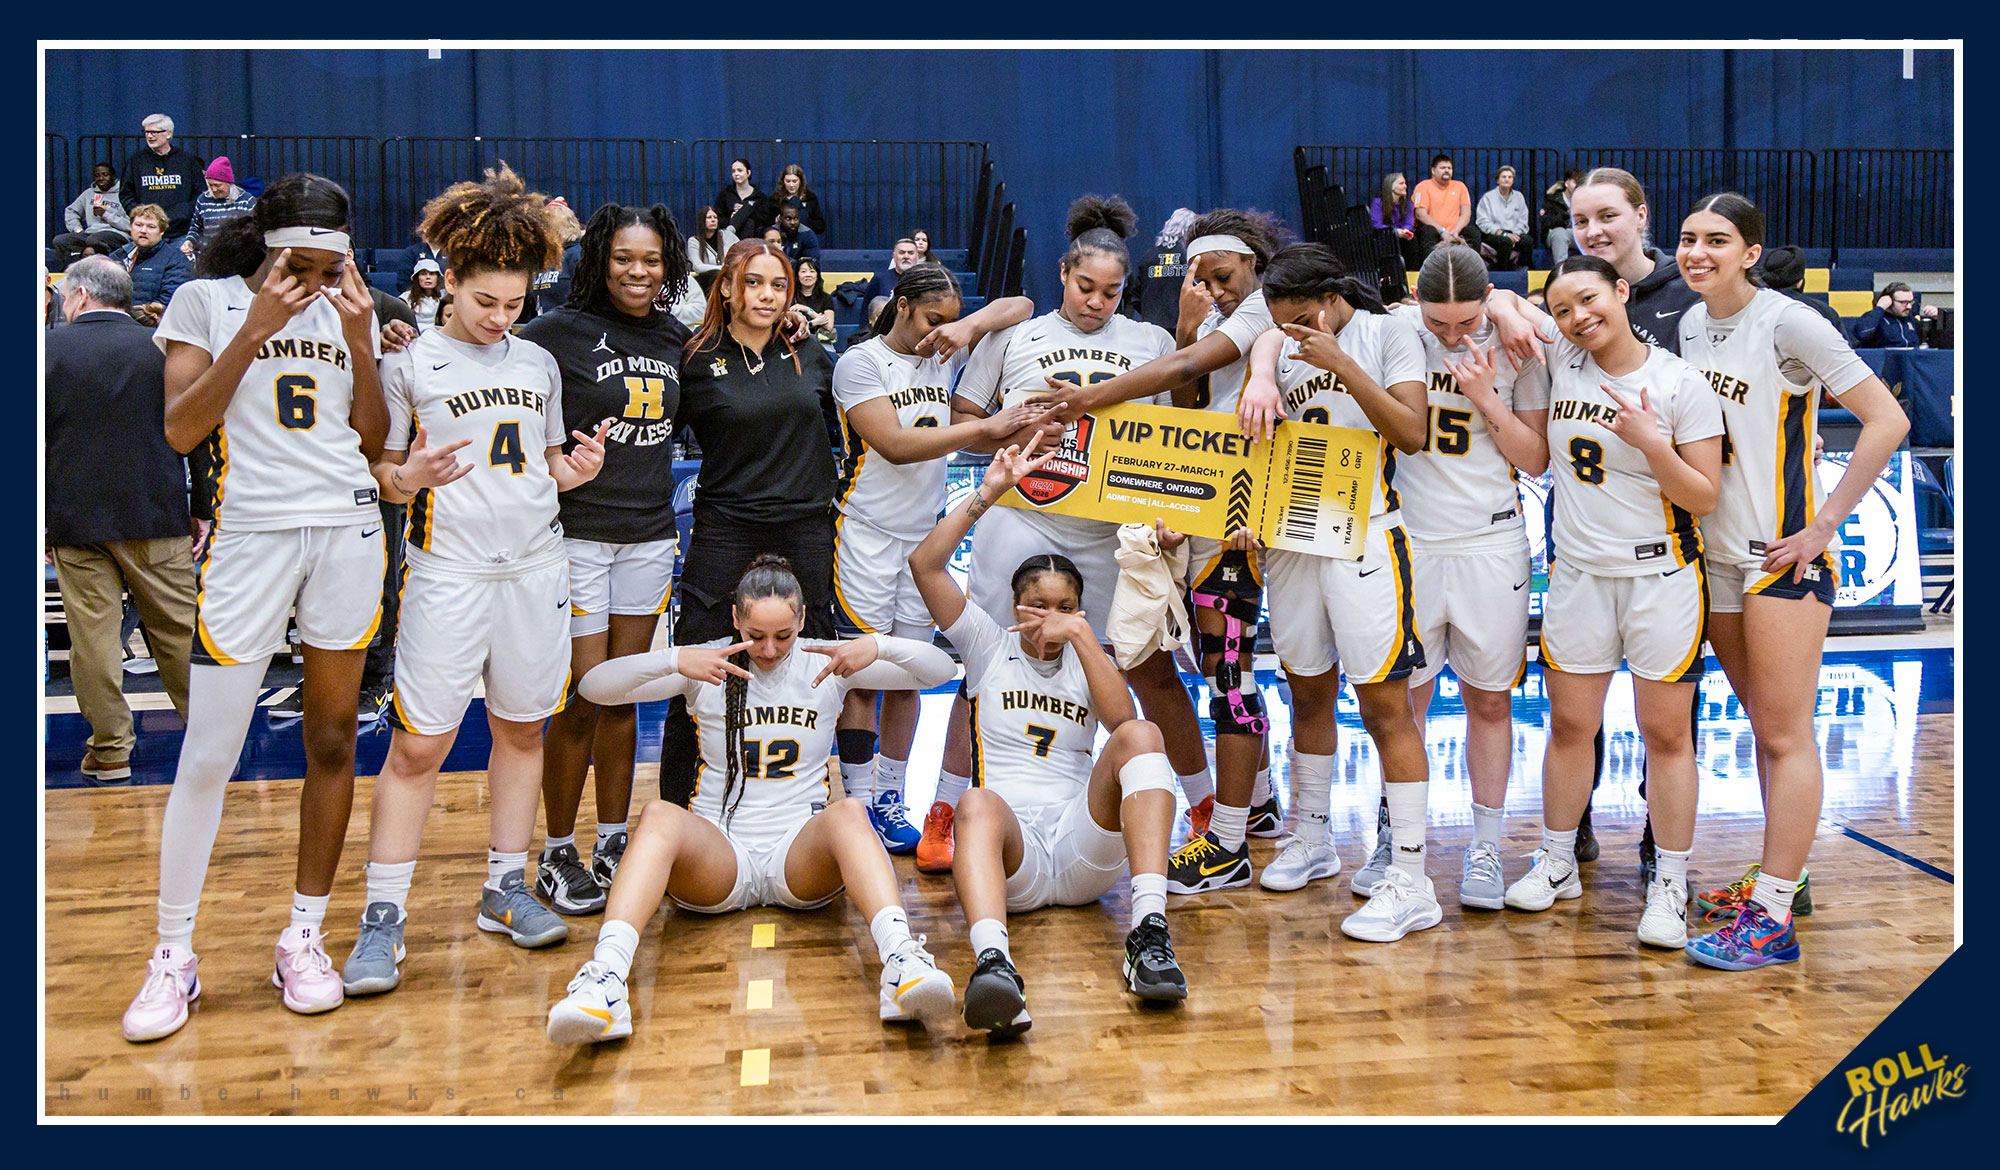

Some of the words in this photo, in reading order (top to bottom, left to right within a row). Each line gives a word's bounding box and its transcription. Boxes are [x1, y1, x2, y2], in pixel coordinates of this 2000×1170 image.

[141, 174, 182, 186] HUMBER
[1148, 265, 1188, 278] GHOSTS
[1158, 253, 1181, 265] THE
[1632, 323, 1661, 349] HAW
[255, 338, 347, 371] UMBER
[1037, 346, 1132, 372] HUMBER
[597, 358, 623, 382] DO
[627, 356, 680, 385] MORE
[623, 376, 665, 419] H
[1286, 371, 1352, 413] HUMBE
[1700, 369, 1750, 405] BER
[274, 372, 318, 432] 6
[444, 387, 544, 418] HUMBER
[1552, 400, 1618, 424] HUMB
[593, 417, 636, 444] SAY
[635, 419, 673, 446] LESS
[1109, 418, 1153, 444] VIP
[1159, 425, 1254, 458] TICKET
[488, 420, 528, 476] 4
[1355, 450, 1363, 469] GRIT
[1568, 435, 1607, 487] 8
[1029, 457, 1087, 478] IONSHIP
[1112, 455, 1162, 469] FEBRUARY
[1219, 470, 1224, 478] 1
[1030, 480, 1054, 491] OCAA
[1031, 489, 1050, 498] 2026
[1109, 475, 1165, 492] SOMEWHERE,
[1166, 483, 1205, 495] ONTARIO
[1349, 480, 1358, 511] CHAMP
[1106, 492, 1131, 503] ADMIT
[1131, 496, 1147, 505] ONE
[1151, 499, 1200, 513] ALL-ACCESS
[1332, 525, 1341, 533] 4
[1344, 517, 1354, 545] TEAMS
[722, 705, 818, 731] UMBER
[1001, 690, 1089, 728] HUMBER
[1025, 722, 1057, 758] 7
[743, 738, 801, 779] 12
